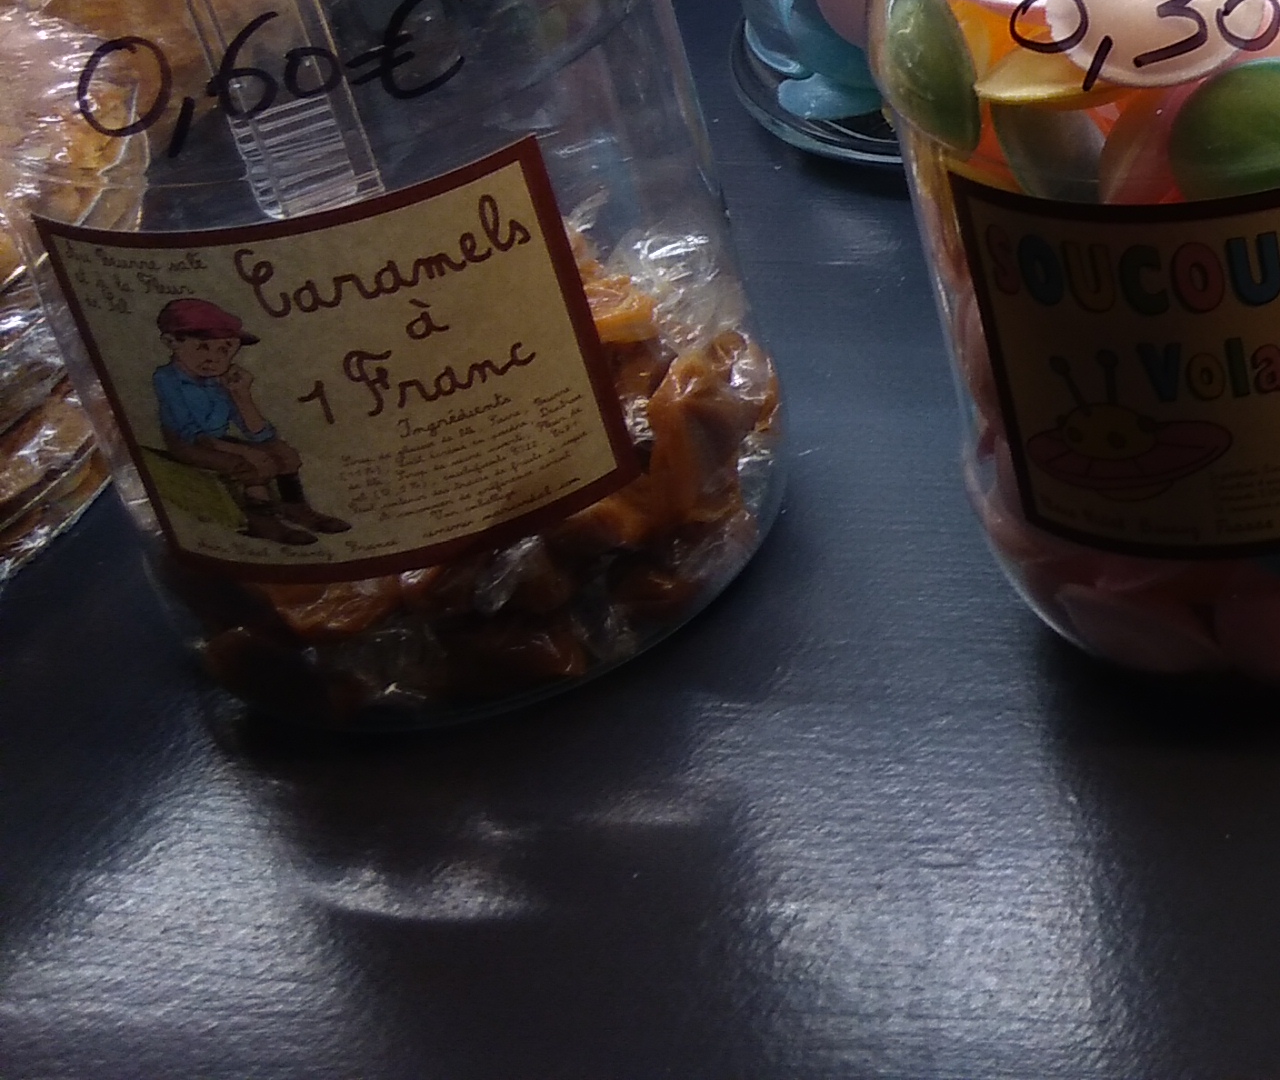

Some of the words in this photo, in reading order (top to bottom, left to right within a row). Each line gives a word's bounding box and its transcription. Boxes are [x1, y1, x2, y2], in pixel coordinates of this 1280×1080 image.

[234, 194, 532, 318] Caramels
[405, 298, 450, 340] à
[297, 380, 336, 425] 1
[342, 341, 537, 417] Franc
